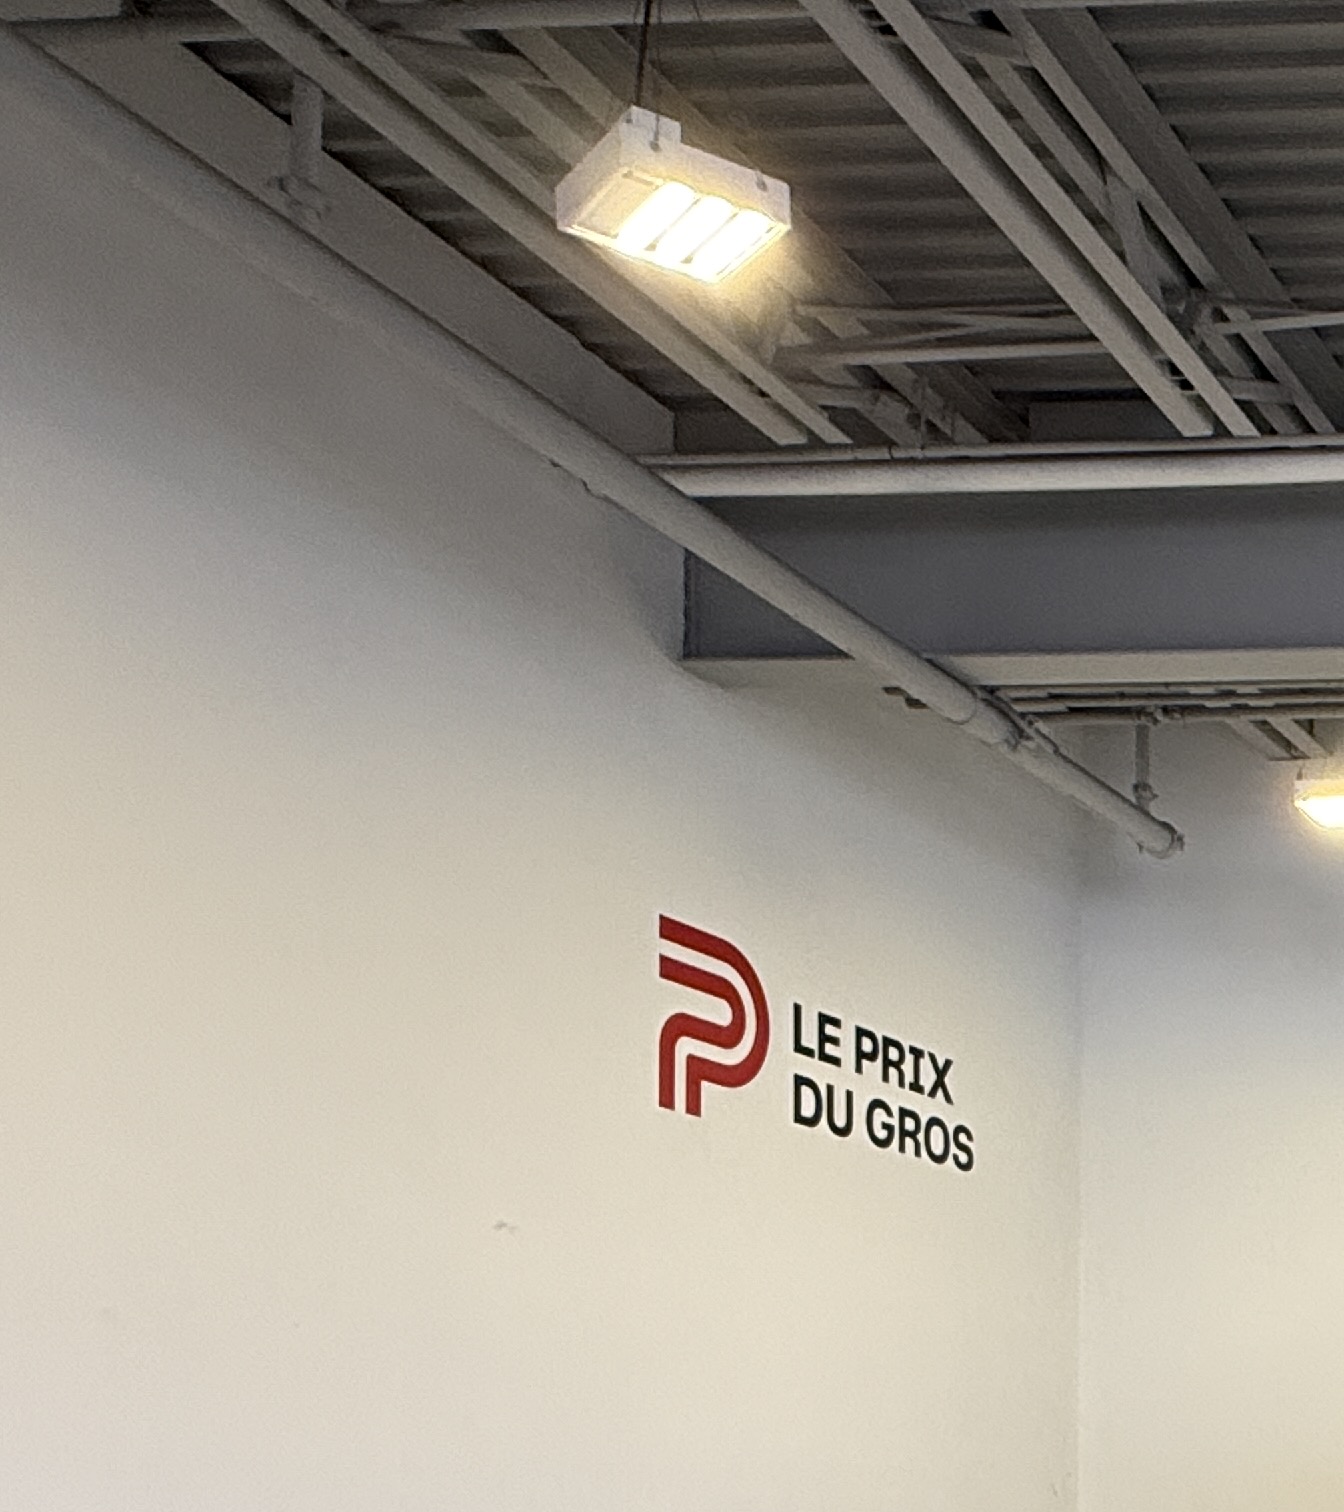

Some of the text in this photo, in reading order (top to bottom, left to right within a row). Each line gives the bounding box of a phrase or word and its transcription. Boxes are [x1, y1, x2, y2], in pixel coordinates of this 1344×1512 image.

[793, 1002, 954, 1105] LE PRIX
[793, 1074, 974, 1172] DU GROS
